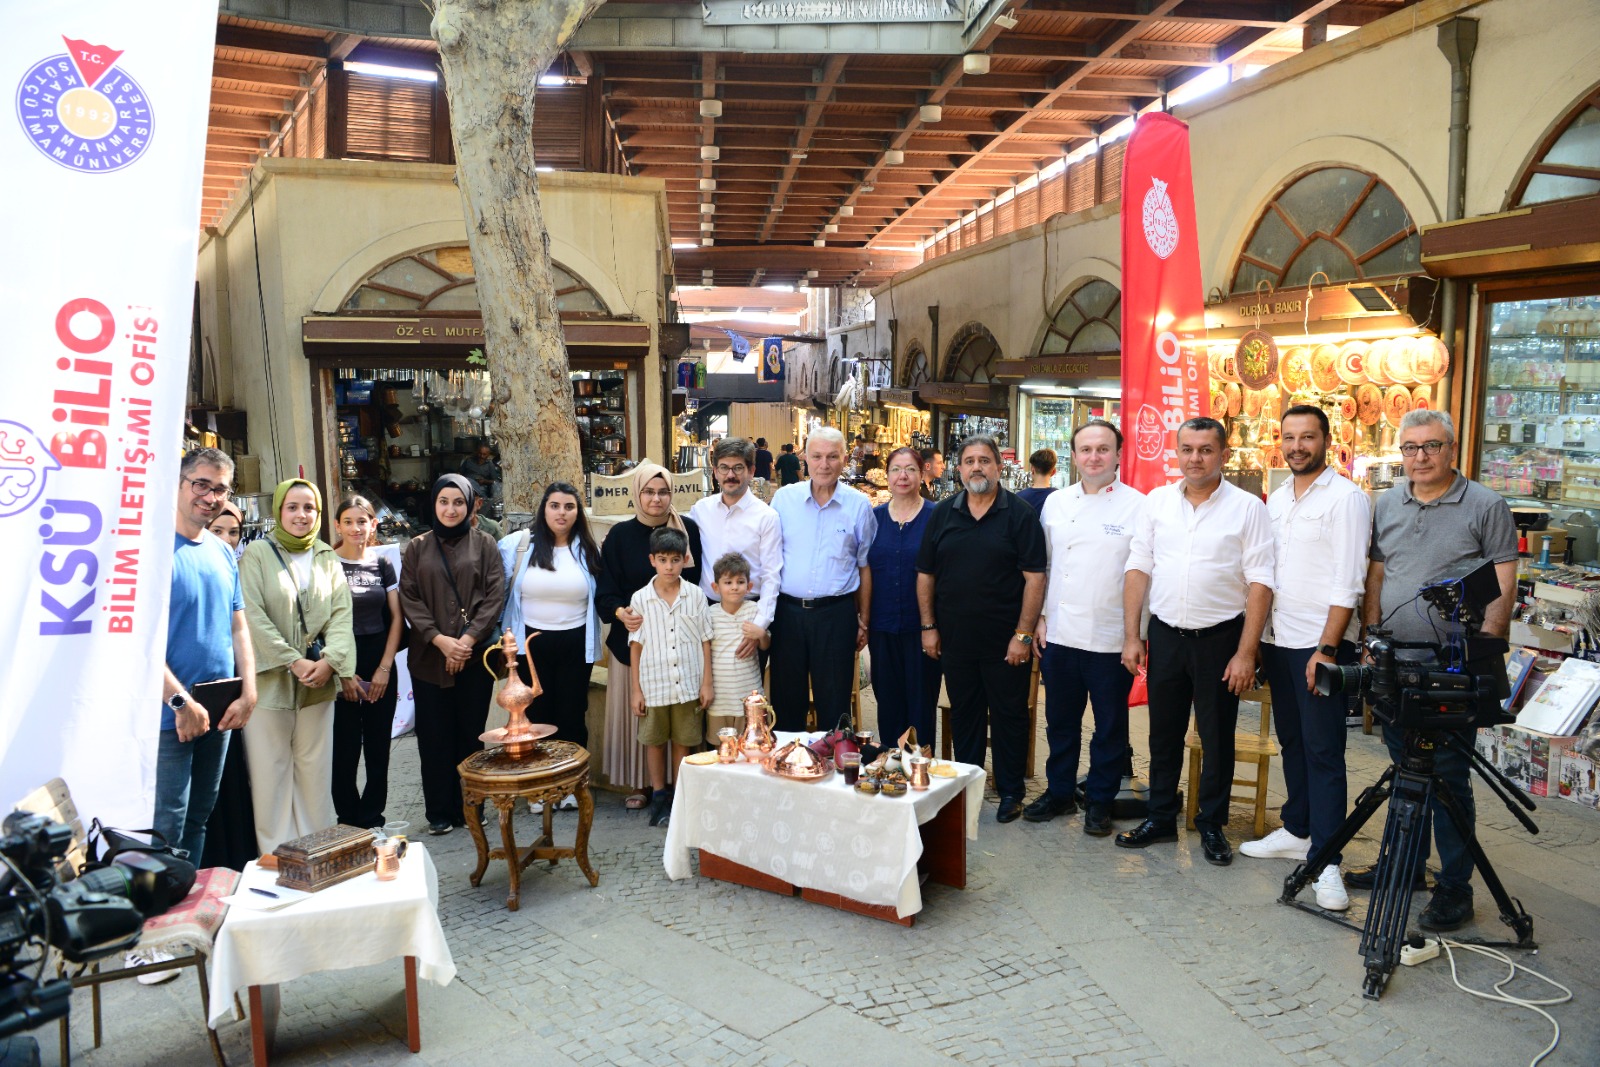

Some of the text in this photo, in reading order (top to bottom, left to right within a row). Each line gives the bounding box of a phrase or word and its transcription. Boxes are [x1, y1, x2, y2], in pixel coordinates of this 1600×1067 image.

[80, 50, 104, 65] T.C.
[41, 75, 132, 153] KAHRAMANMARAŞ
[63, 103, 111, 123] 1992
[1274, 300, 1302, 314] BAKIR
[1182, 333, 1198, 381] OFİİ
[595, 486, 629, 498] ÖMER
[38, 498, 103, 636] KSÜ
[102, 549, 140, 634] BİLİM
